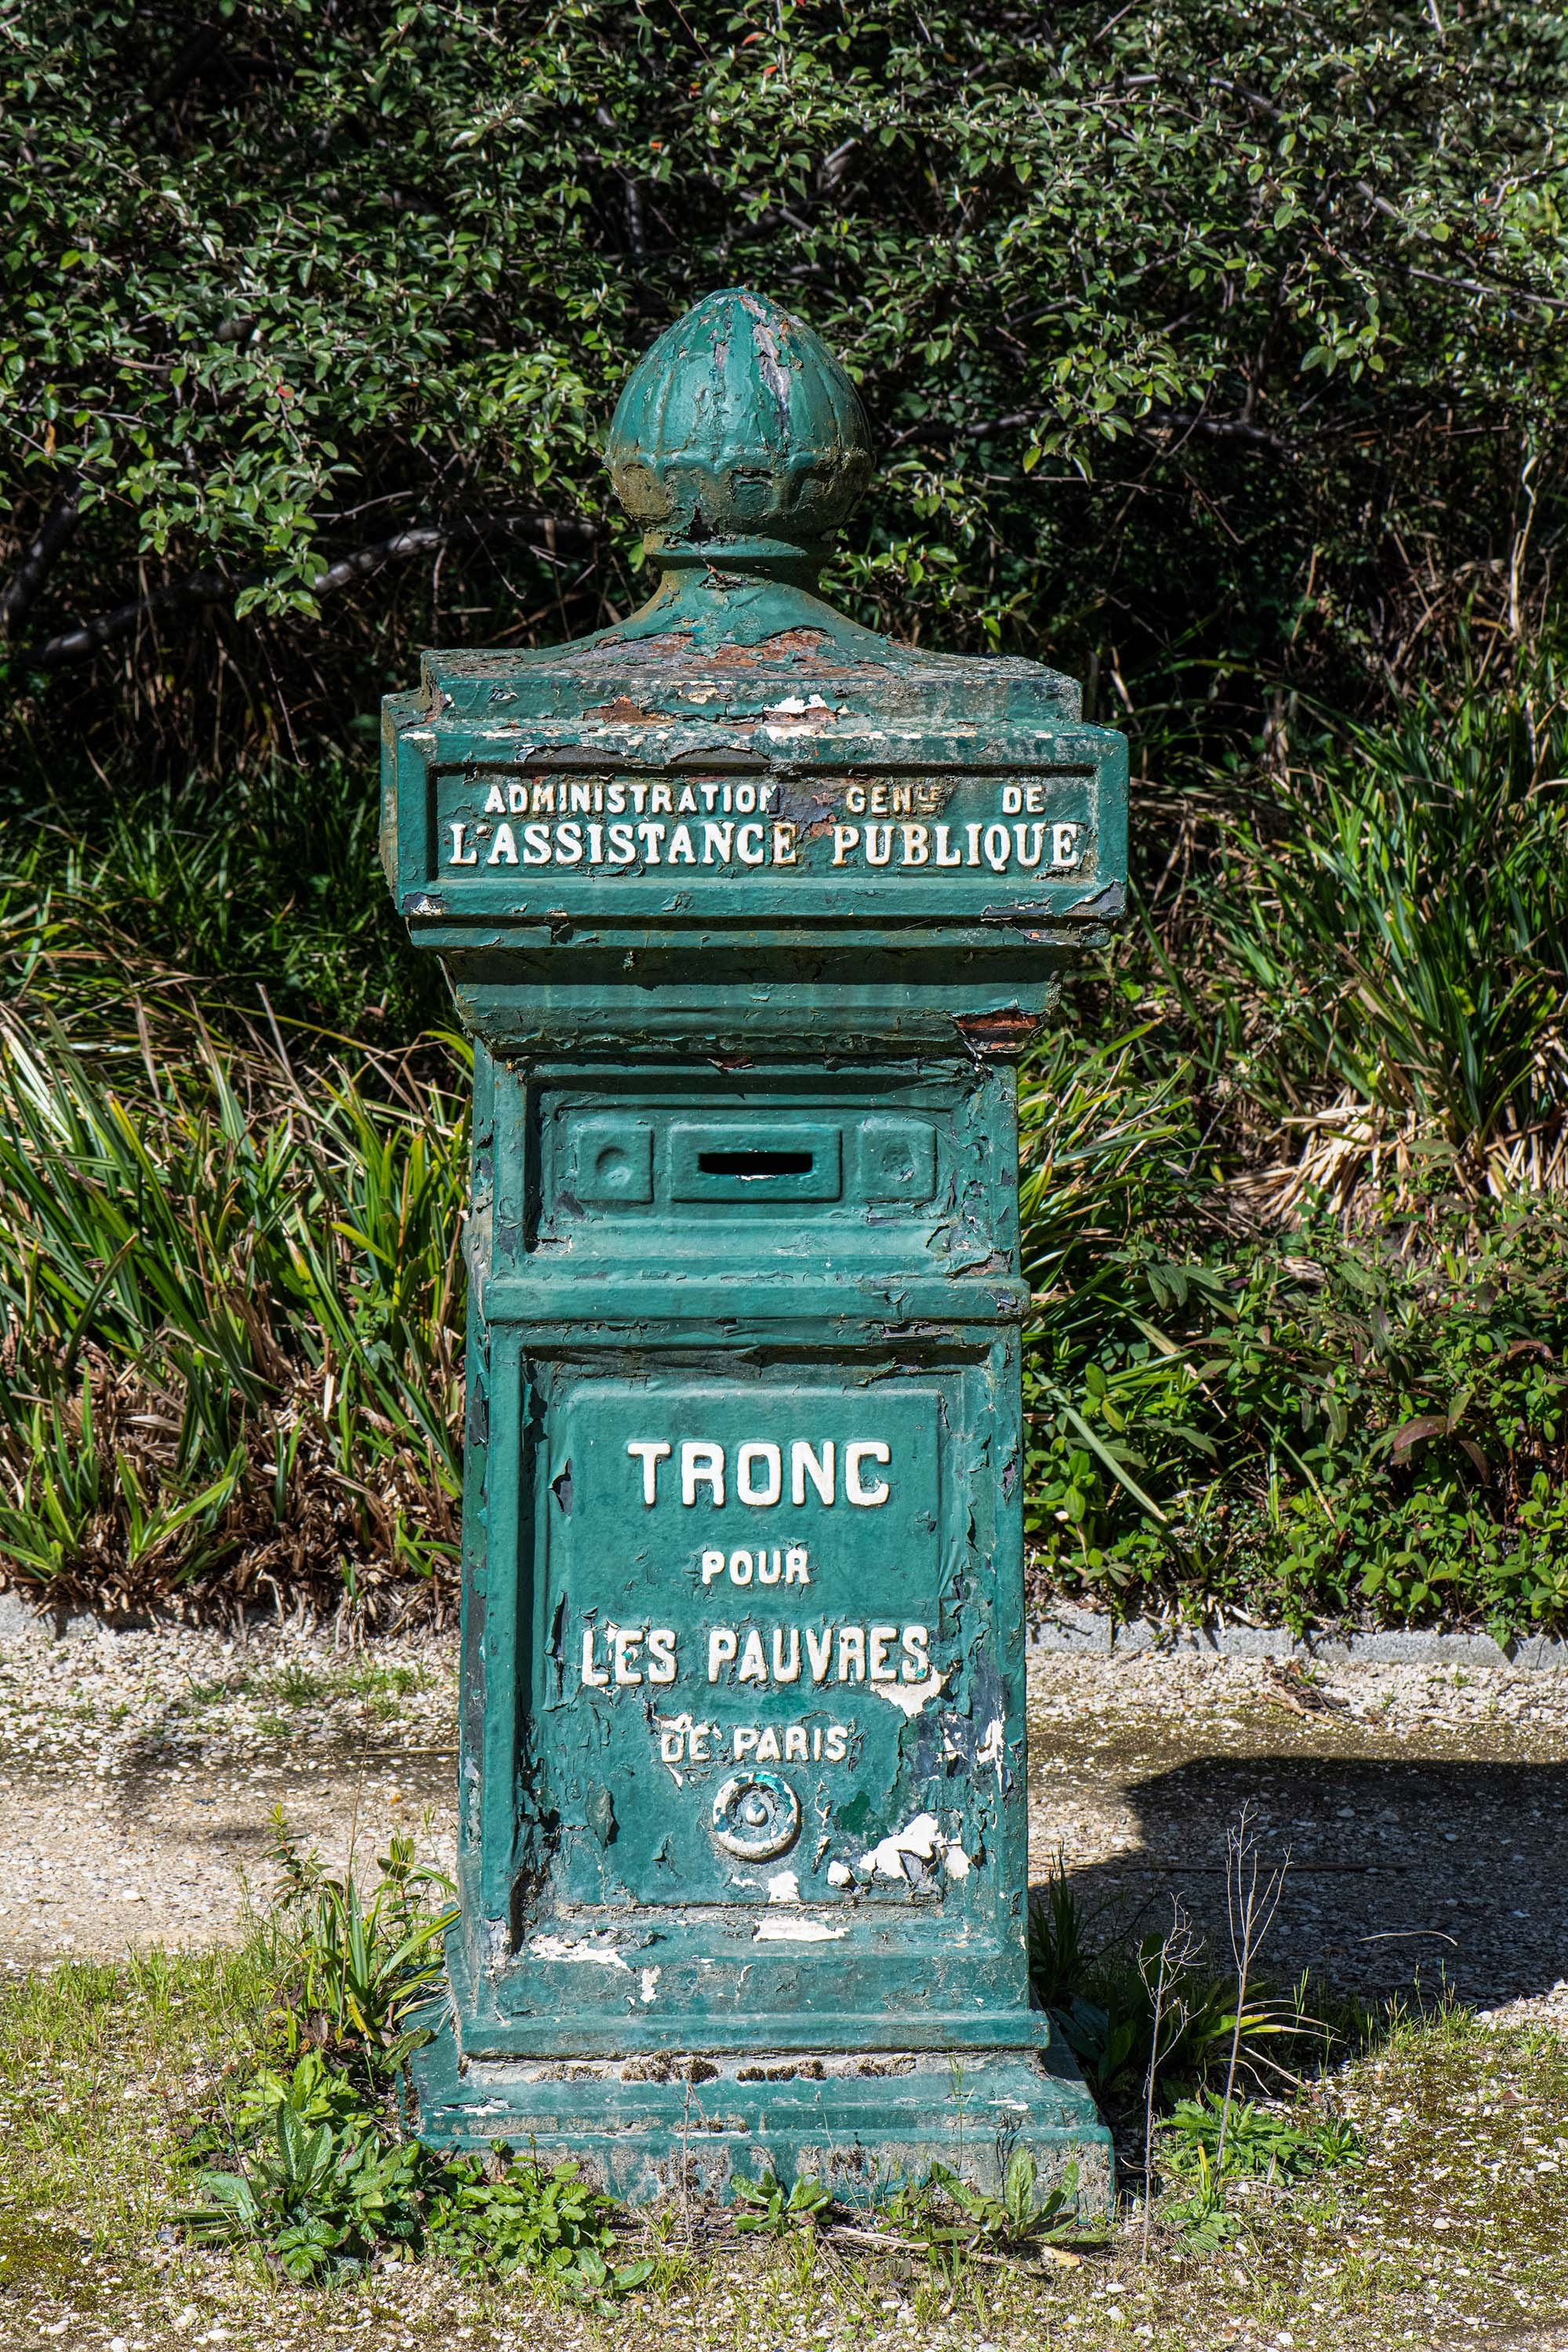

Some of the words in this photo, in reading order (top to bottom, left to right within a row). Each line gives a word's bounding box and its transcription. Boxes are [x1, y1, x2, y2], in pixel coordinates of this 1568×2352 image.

[1002, 786, 1045, 815] DE
[832, 823, 1079, 872] PUBLIQUE
[627, 1441, 891, 1506] TRONC
[702, 1548, 809, 1585] POUR
[581, 1629, 677, 1686] LES
[708, 1626, 931, 1683] PAUVRES
[660, 1726, 713, 1762] DE
[733, 1726, 848, 1762] PARIS
